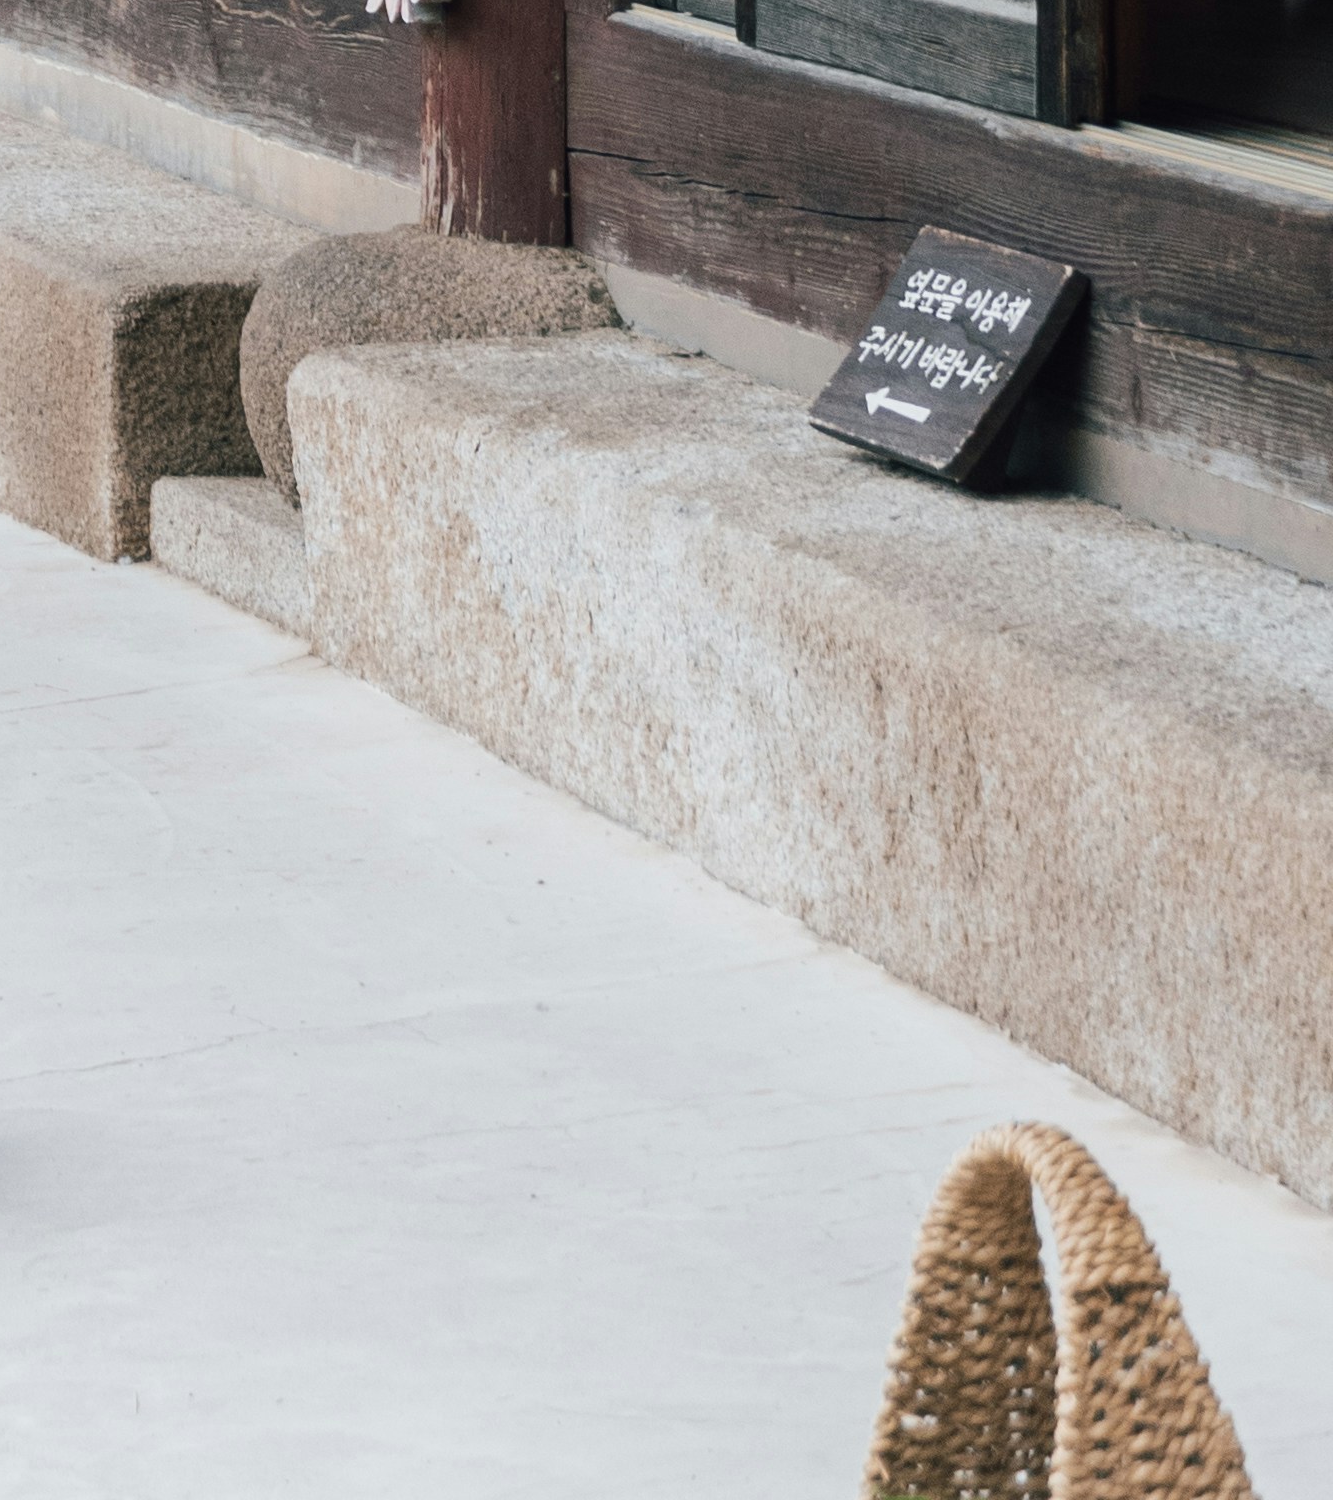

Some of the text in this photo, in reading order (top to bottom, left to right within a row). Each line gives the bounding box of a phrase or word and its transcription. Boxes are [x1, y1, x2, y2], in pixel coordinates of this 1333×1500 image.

[899, 268, 1032, 334] 옆문을 이용해
[857, 326, 1005, 394] 주시기 바랍니다
